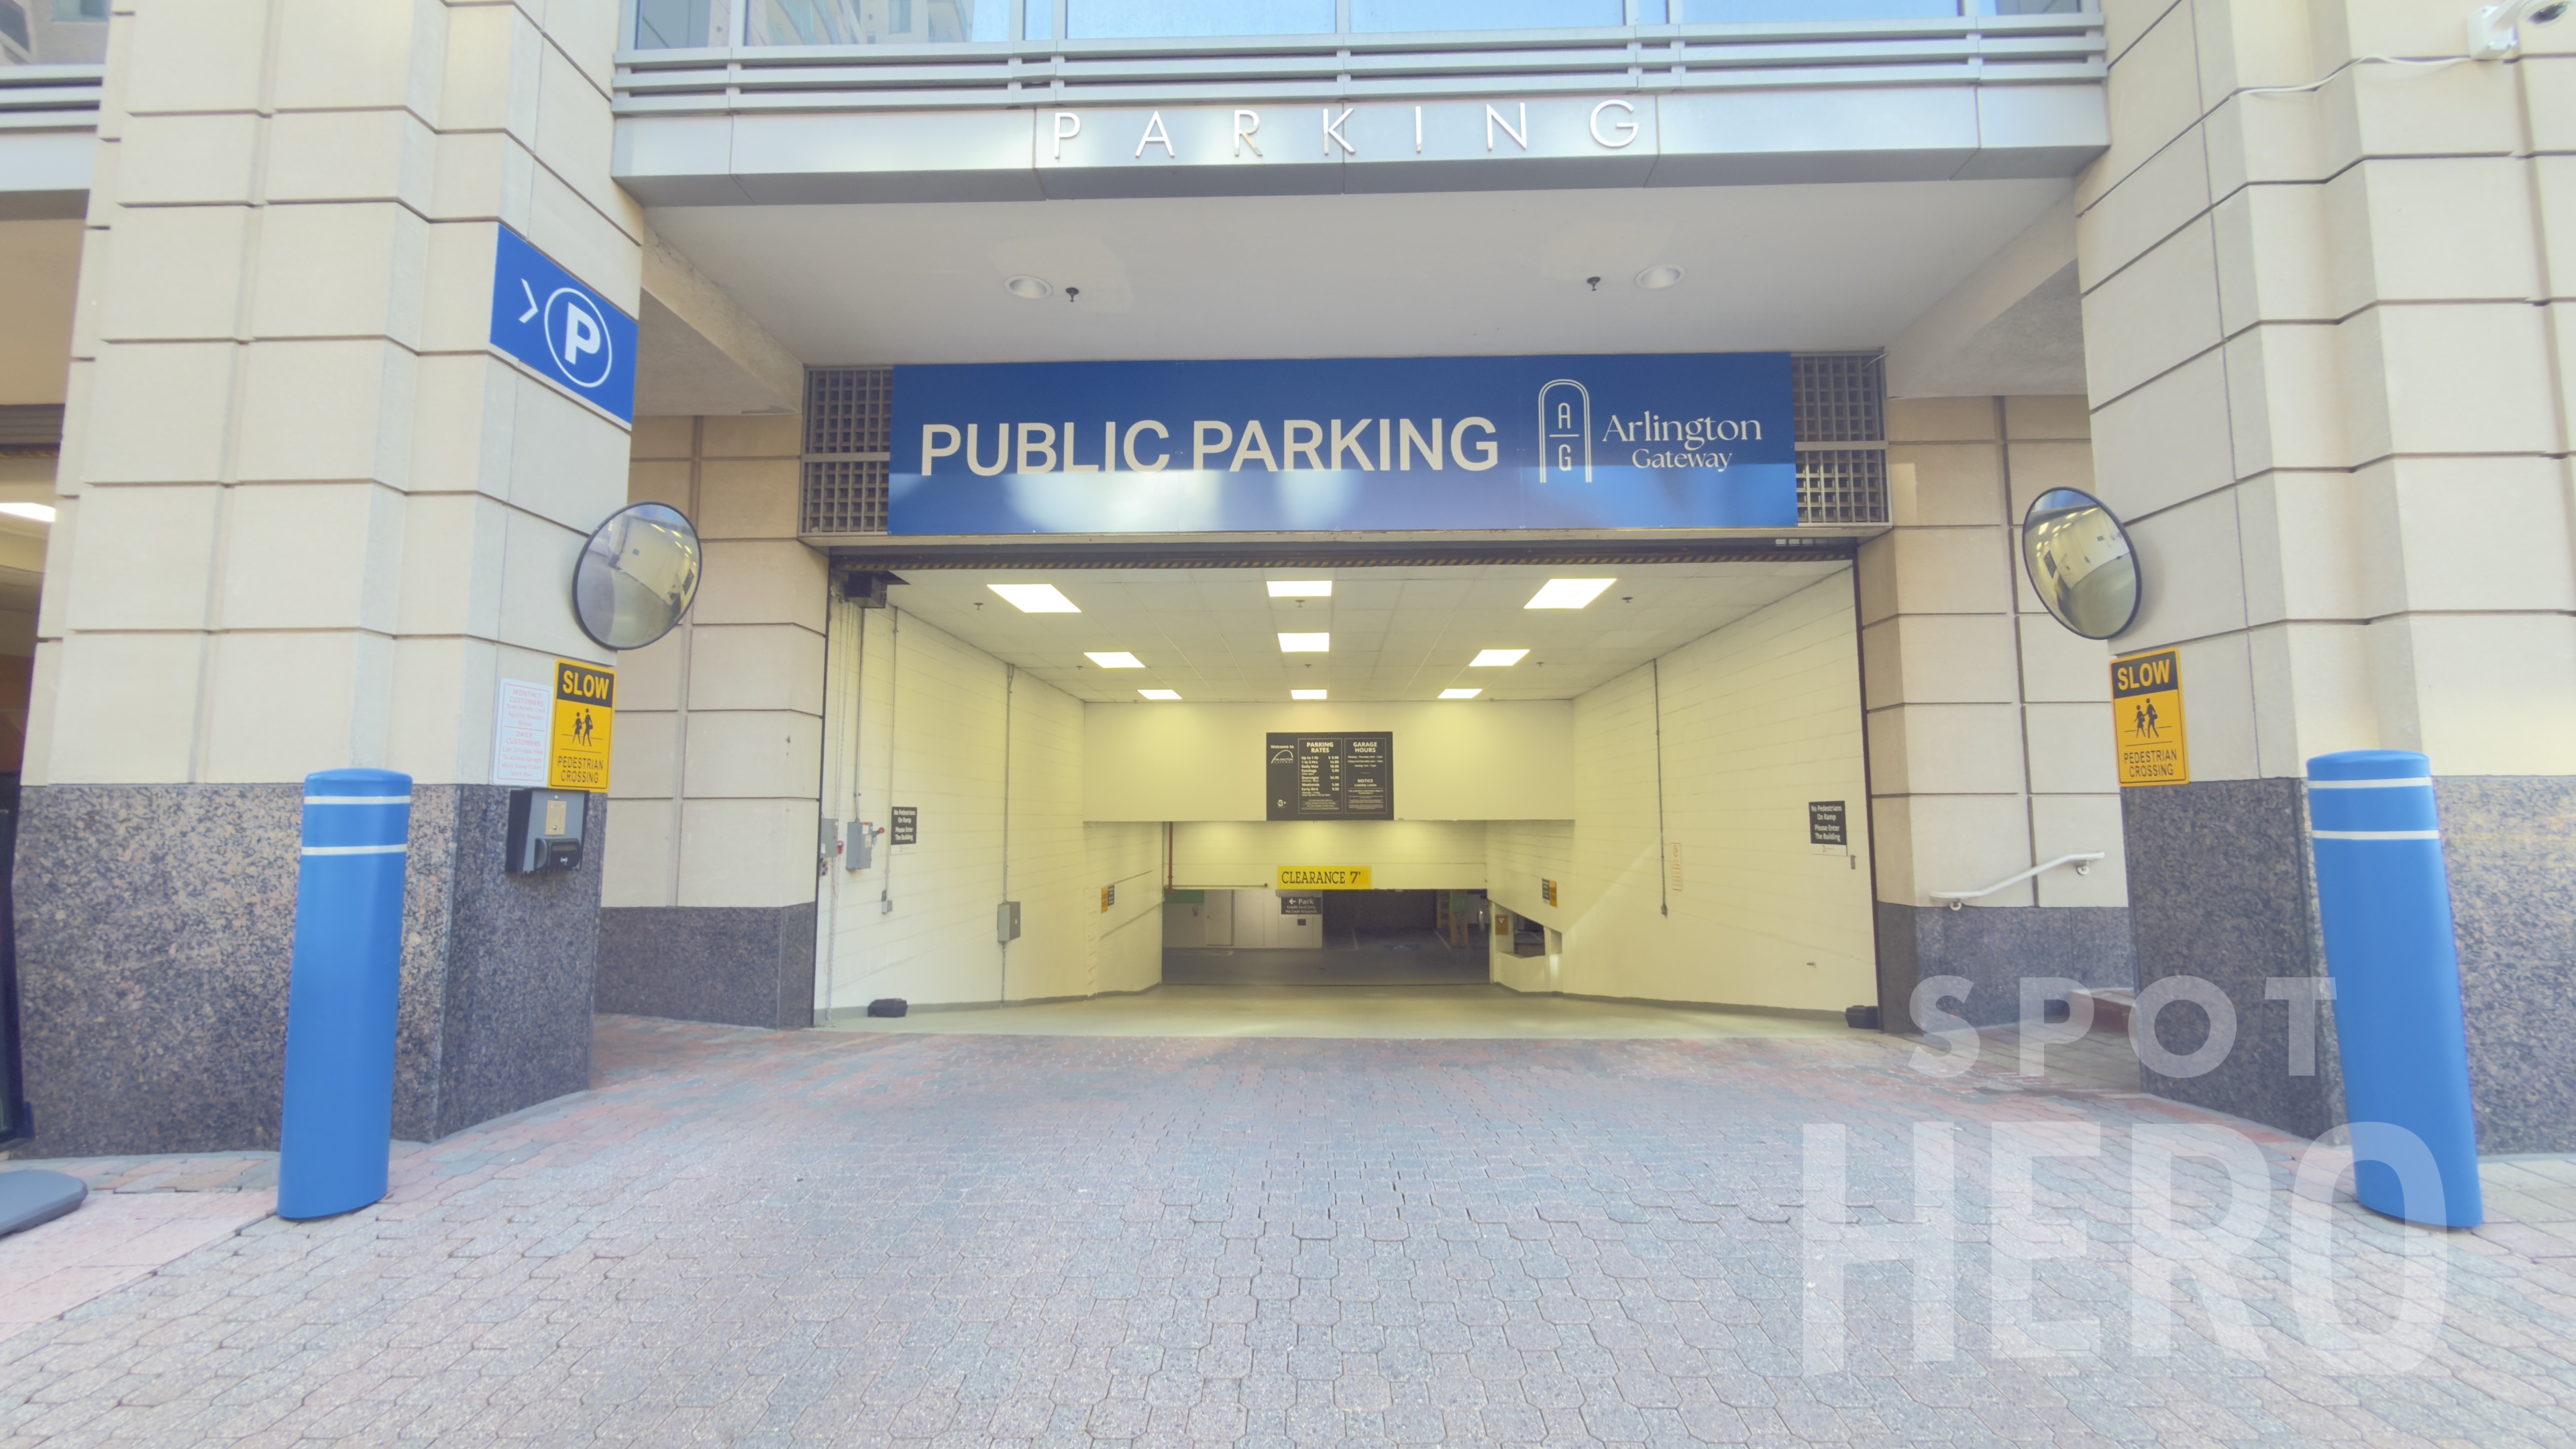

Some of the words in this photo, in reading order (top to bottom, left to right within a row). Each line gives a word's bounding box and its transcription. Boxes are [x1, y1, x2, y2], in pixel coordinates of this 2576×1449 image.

[1054, 99, 1639, 159] PARKING
[565, 301, 601, 365] P
[1558, 402, 1571, 429] A
[1602, 411, 1762, 451] Arlington
[920, 419, 1171, 477] PUBLIC
[1193, 416, 1499, 473] PARKING
[1558, 443, 1572, 472] G
[1631, 448, 1733, 472] Gateway
[2117, 659, 2170, 691] SLOW
[513, 688, 542, 698] MONTHLY
[562, 670, 609, 700] SLOW
[509, 696, 544, 707] CUSTOMERS
[506, 738, 541, 747] CUSTOMERS
[557, 755, 603, 771] PEDESTRIAN
[2124, 749, 2177, 764] PEDESTRIAN
[561, 770, 598, 784] CROSSING
[2129, 763, 2174, 777] CROSSING
[1824, 814, 1836, 822] Ramp
[1823, 833, 1841, 842] Building
[1281, 871, 1345, 883] CLEARANCE
